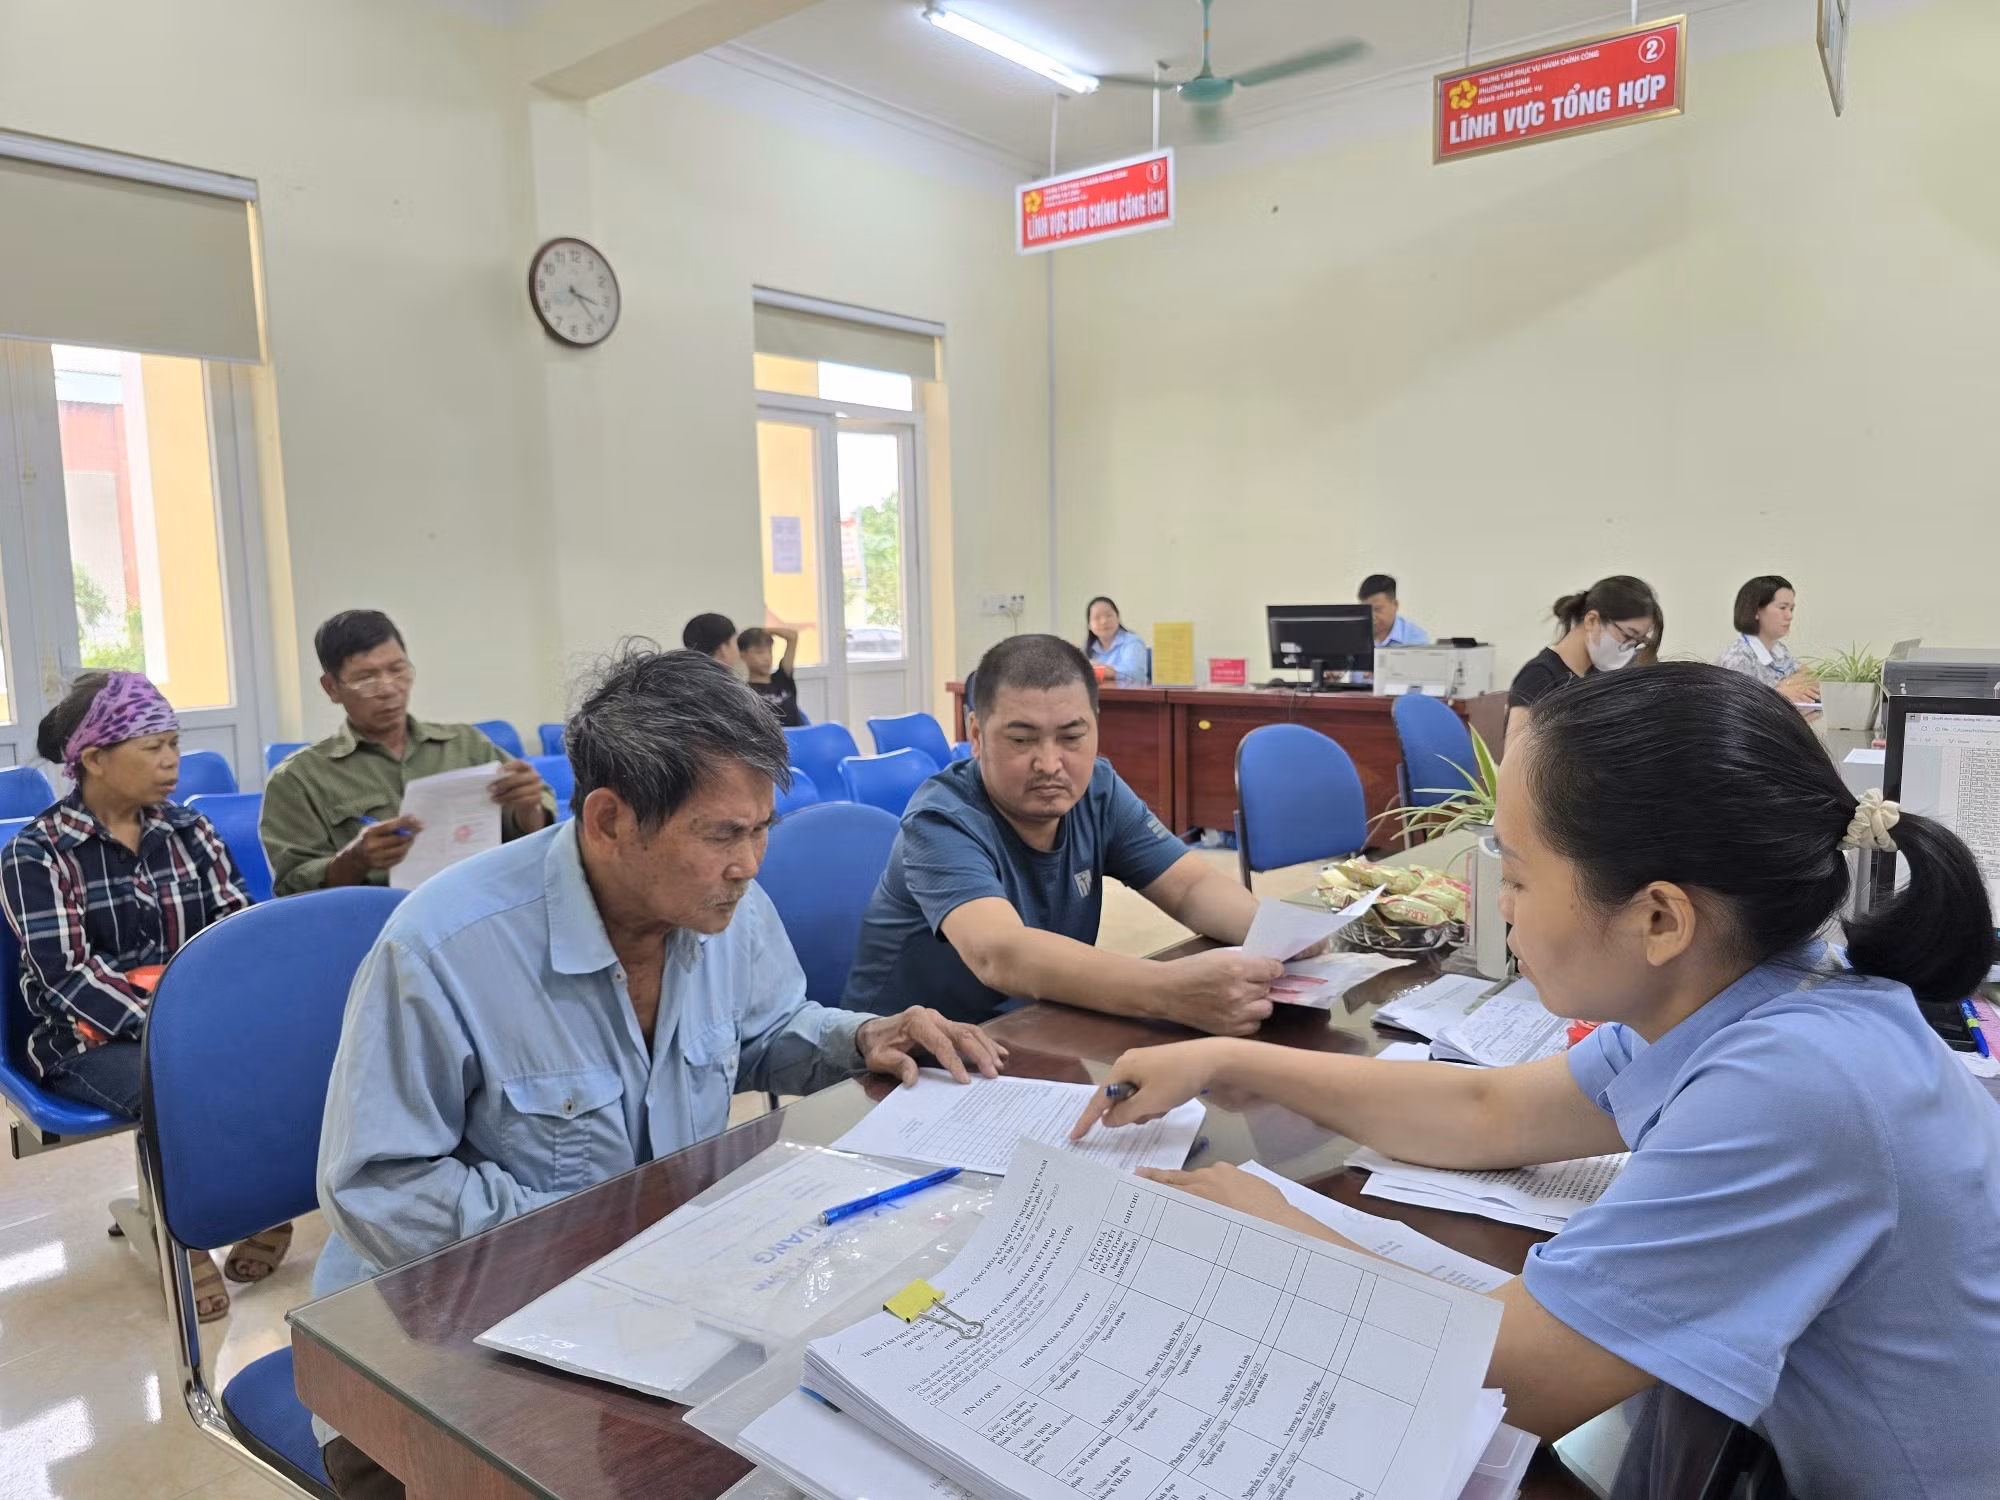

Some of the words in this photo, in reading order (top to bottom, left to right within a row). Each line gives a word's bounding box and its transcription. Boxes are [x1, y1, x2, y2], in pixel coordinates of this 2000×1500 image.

[1646, 40, 1658, 60] 2
[1450, 110, 1497, 144] LĨNH
[1503, 102, 1546, 134] VỰC
[1552, 83, 1611, 122] TỔNG
[1618, 74, 1666, 110] HỢP
[1038, 1159, 1047, 1176] NAM
[1123, 1209, 1132, 1223] GHI
[1181, 1332, 1192, 1346] 2025
[1231, 1369, 1242, 1382] Văn
[1250, 1361, 1262, 1377] 2025
[1317, 1390, 1329, 1405] 2025
